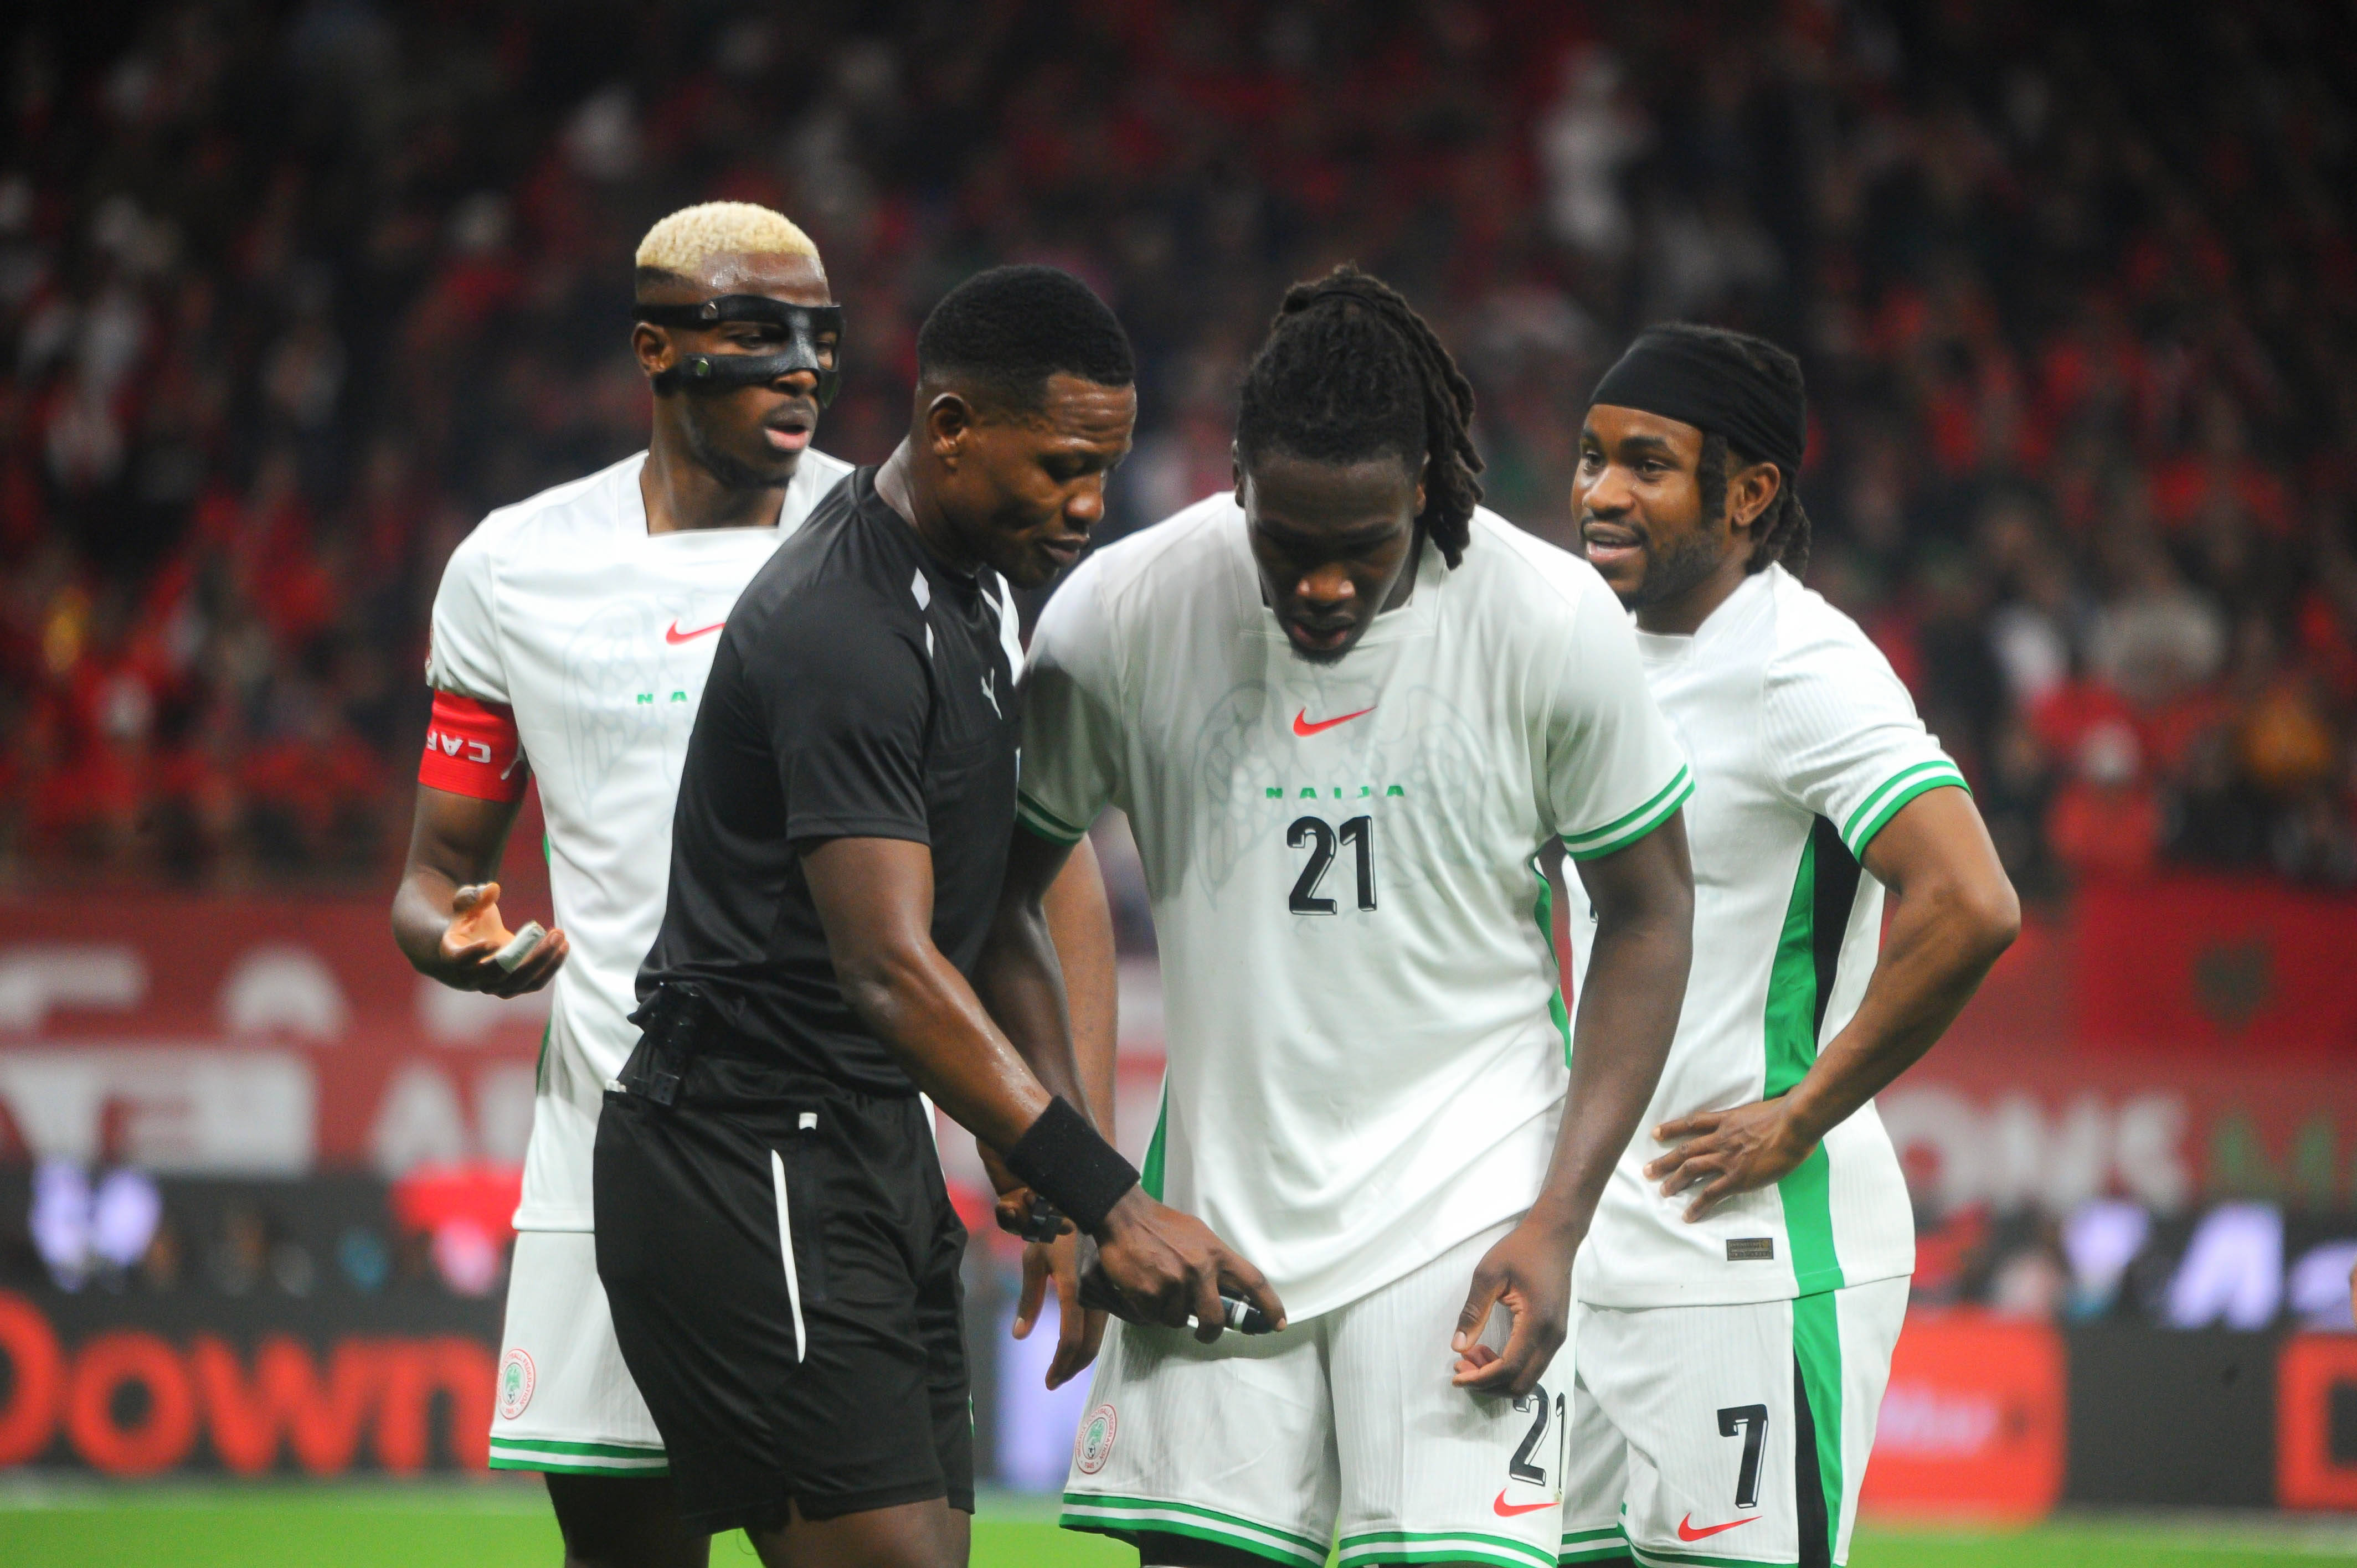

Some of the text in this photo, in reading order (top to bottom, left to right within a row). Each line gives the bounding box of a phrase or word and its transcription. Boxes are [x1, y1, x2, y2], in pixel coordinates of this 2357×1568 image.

[1266, 785, 1405, 799] NAIJA
[1286, 815, 1377, 916] 21
[1509, 1383, 1567, 1495] 21
[1717, 1404, 1769, 1509] 7
